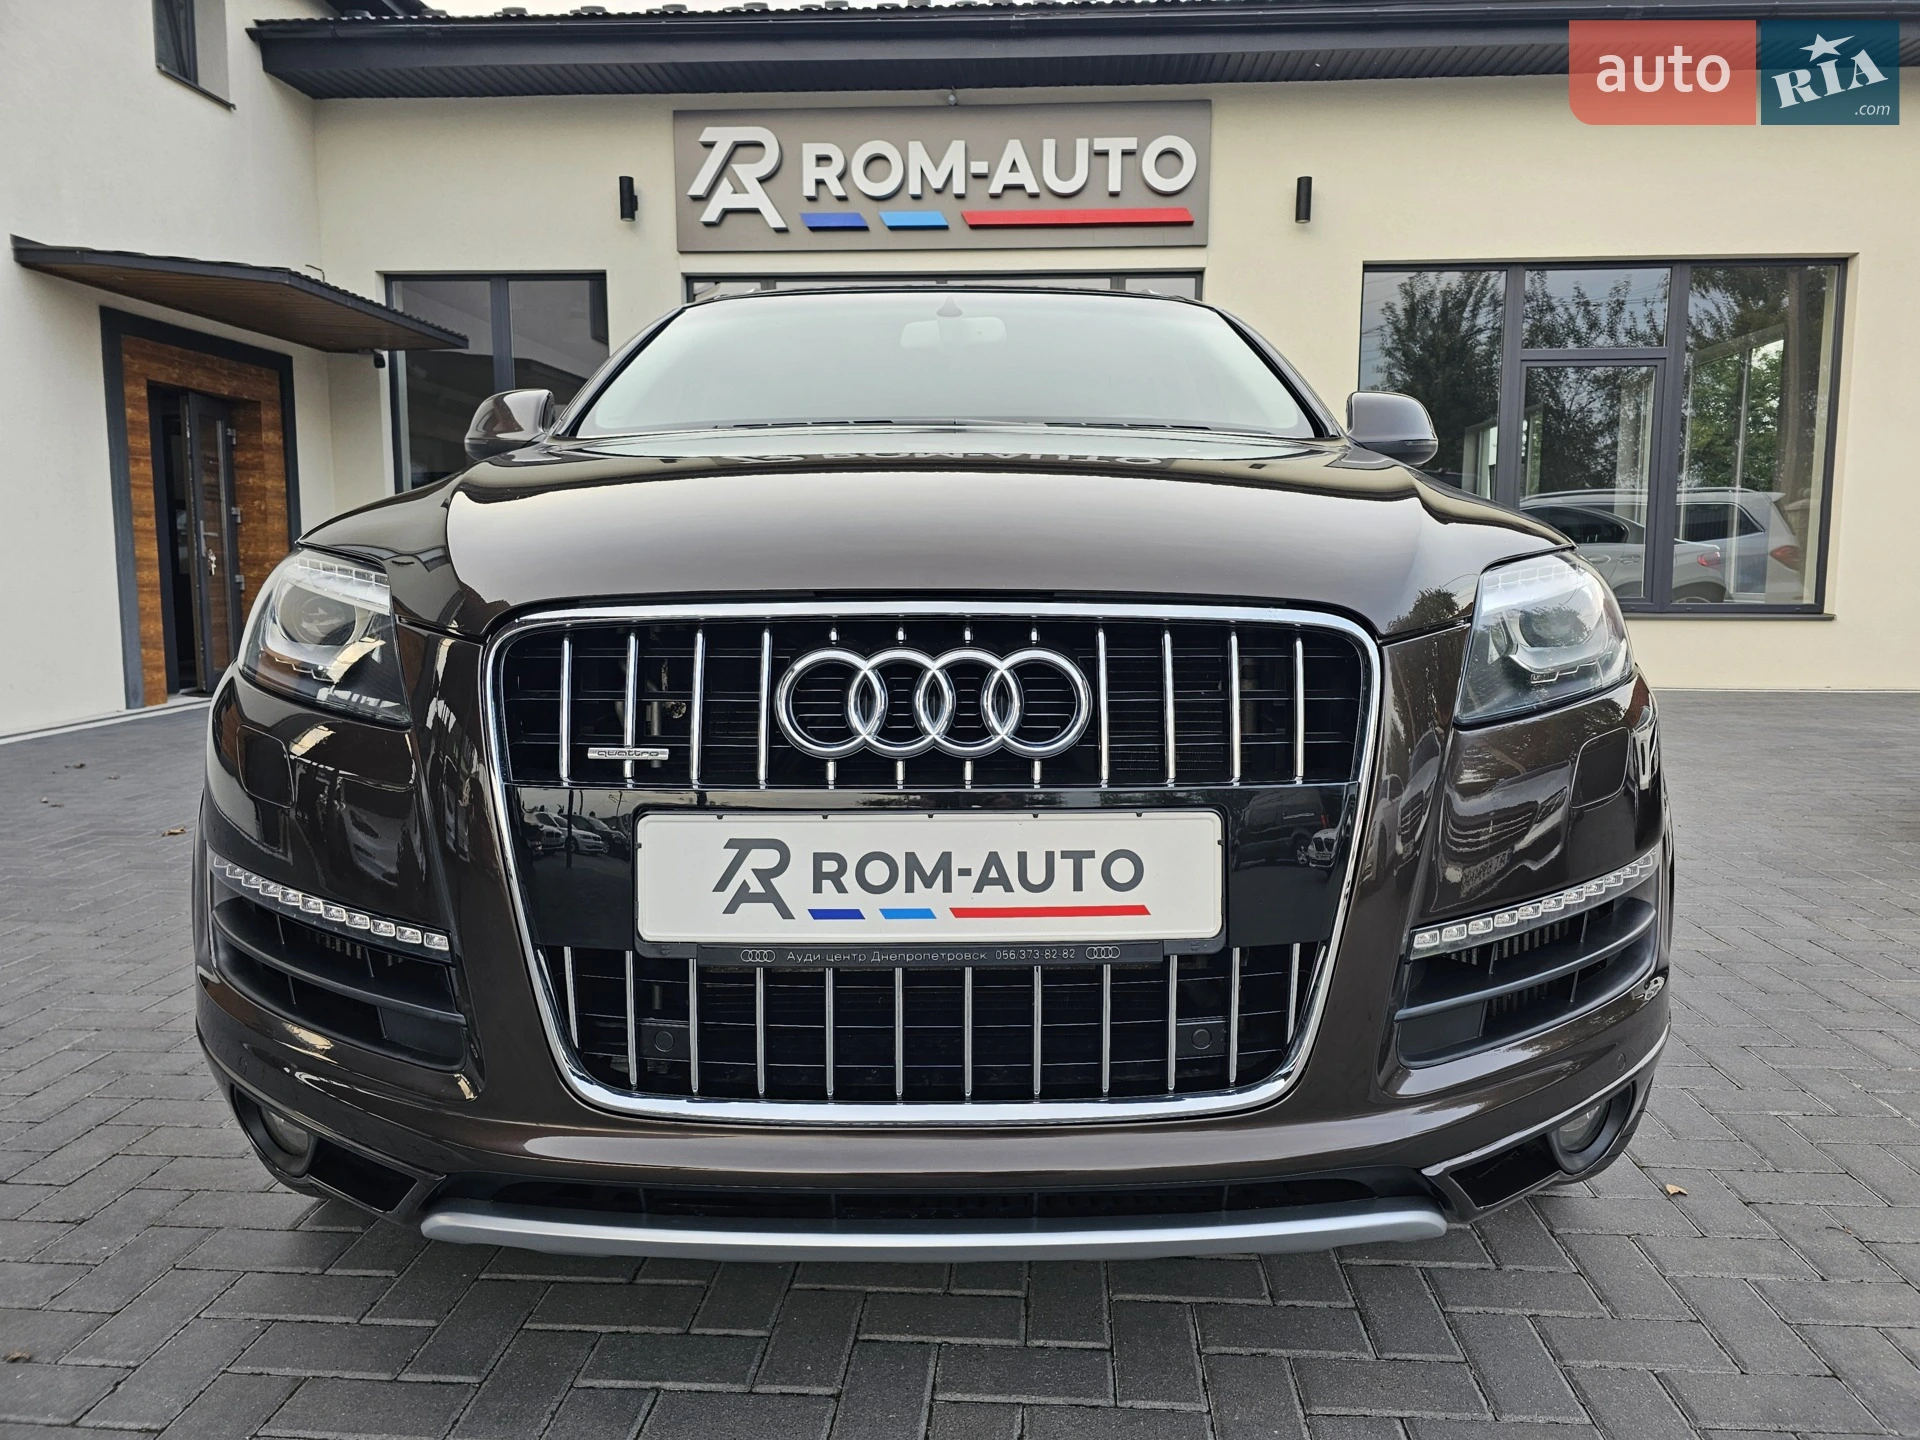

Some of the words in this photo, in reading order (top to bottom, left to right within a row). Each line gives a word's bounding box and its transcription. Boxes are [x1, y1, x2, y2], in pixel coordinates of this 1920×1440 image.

[802, 135, 1198, 200] ROM-AUTO
[813, 849, 1145, 894] ROM-AUTO
[870, 951, 988, 962] Днепропетровск
